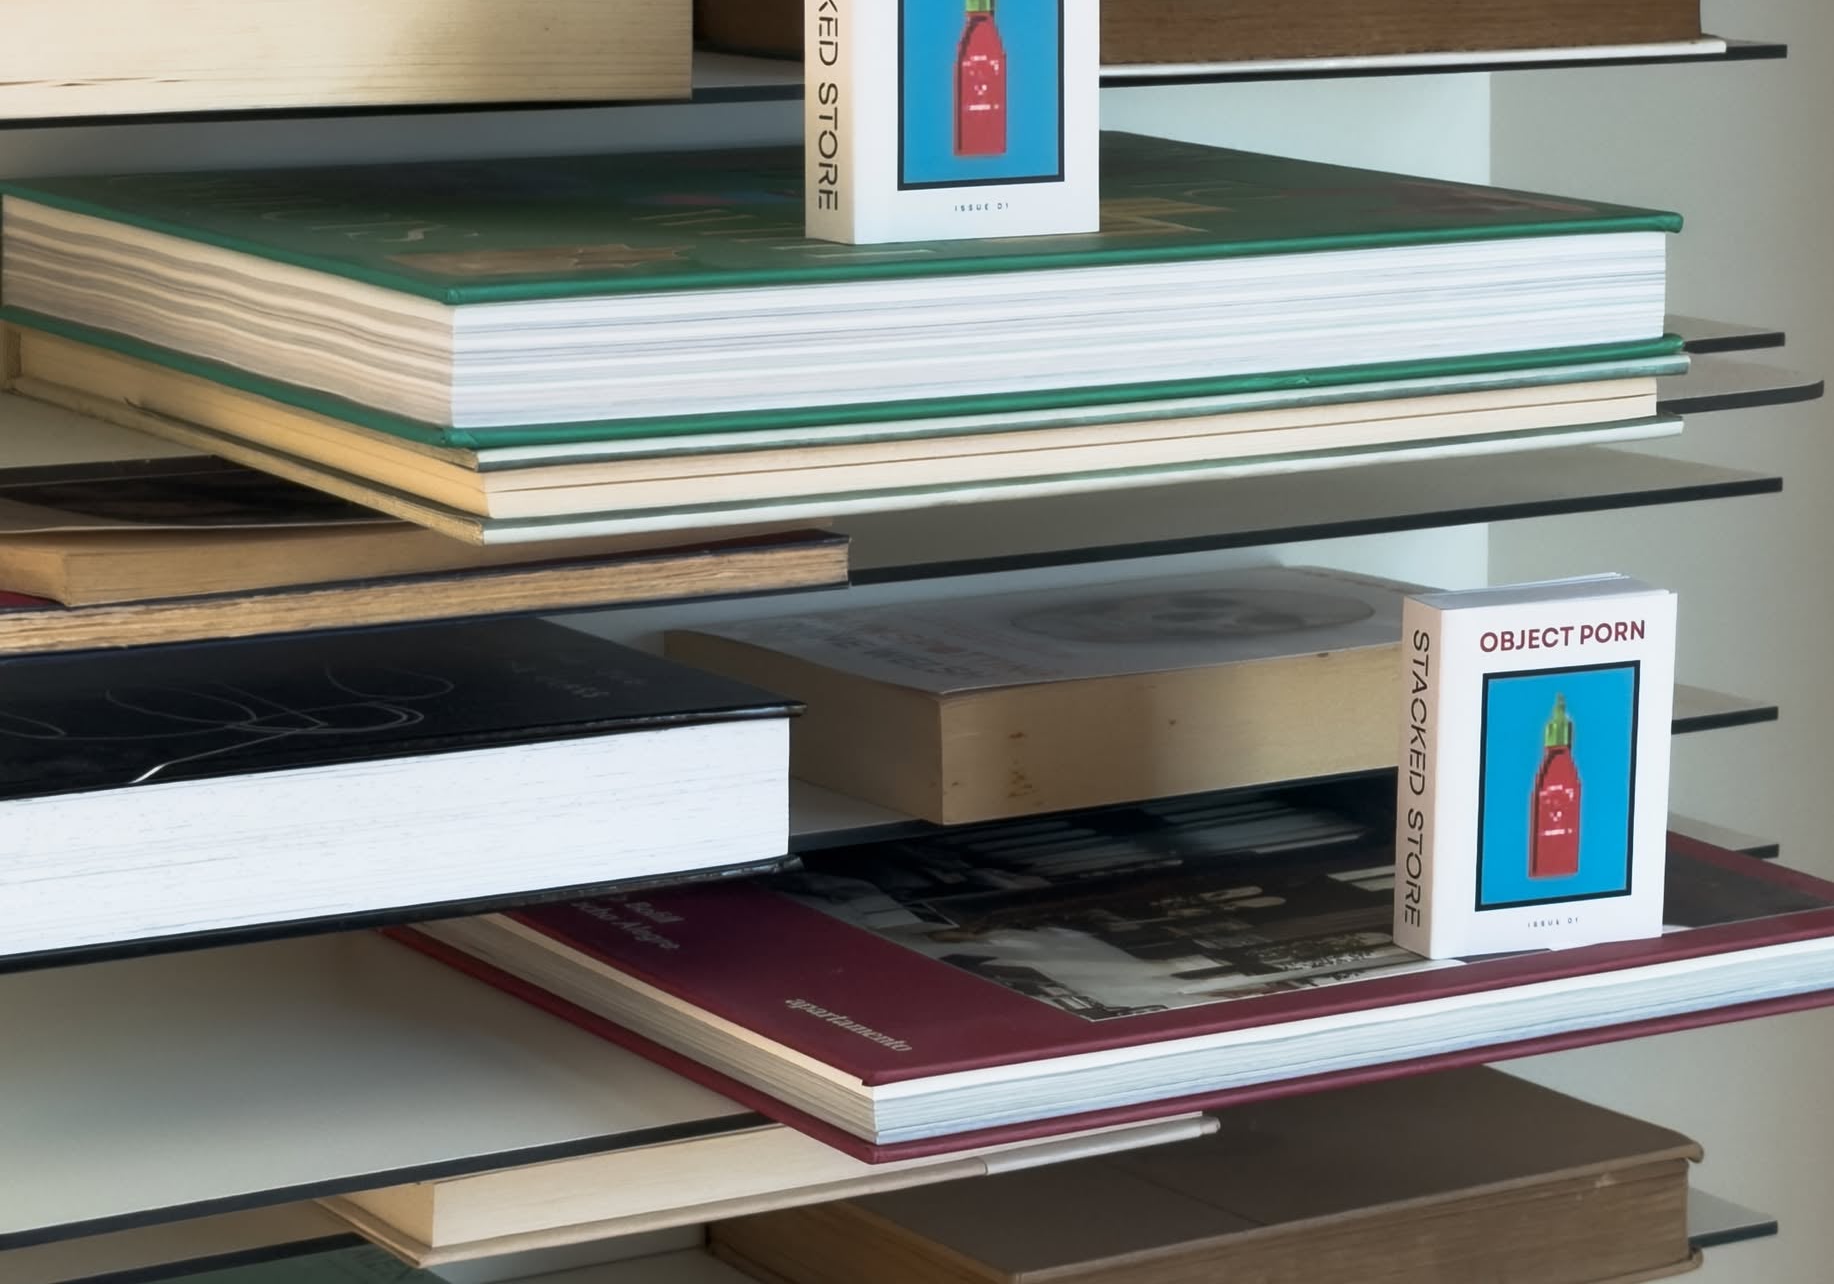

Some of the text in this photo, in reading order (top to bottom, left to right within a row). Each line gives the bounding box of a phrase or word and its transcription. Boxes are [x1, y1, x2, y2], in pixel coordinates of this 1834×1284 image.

[818, 82, 839, 212] STORE
[954, 203, 989, 212] ISSUE
[1480, 619, 1647, 653] OBJECT PORN
[1404, 629, 1430, 928] STACKED STORE
[1527, 918, 1560, 928] ISSUE
[785, 998, 913, 1052] apartamento
